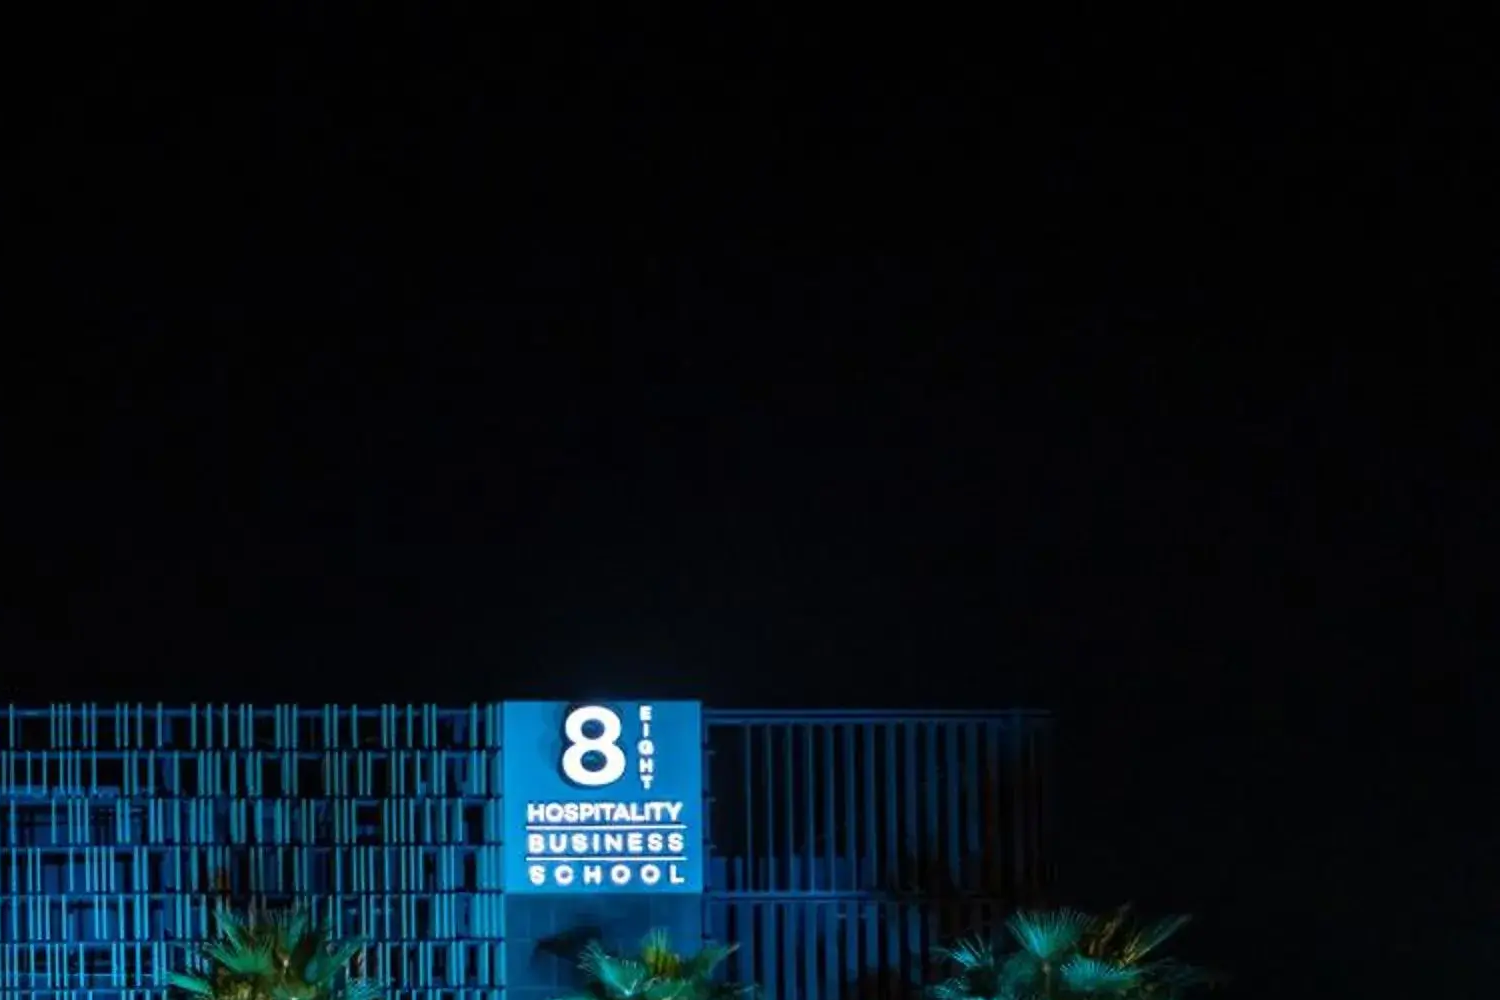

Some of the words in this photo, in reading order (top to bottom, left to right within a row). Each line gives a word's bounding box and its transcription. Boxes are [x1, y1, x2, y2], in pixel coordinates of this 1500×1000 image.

[562, 705, 626, 786] 8
[638, 705, 654, 789] EIGHT
[526, 802, 683, 823] HOSPITALITY
[528, 832, 685, 854] BUSINESS
[528, 864, 685, 885] SCHOOL
